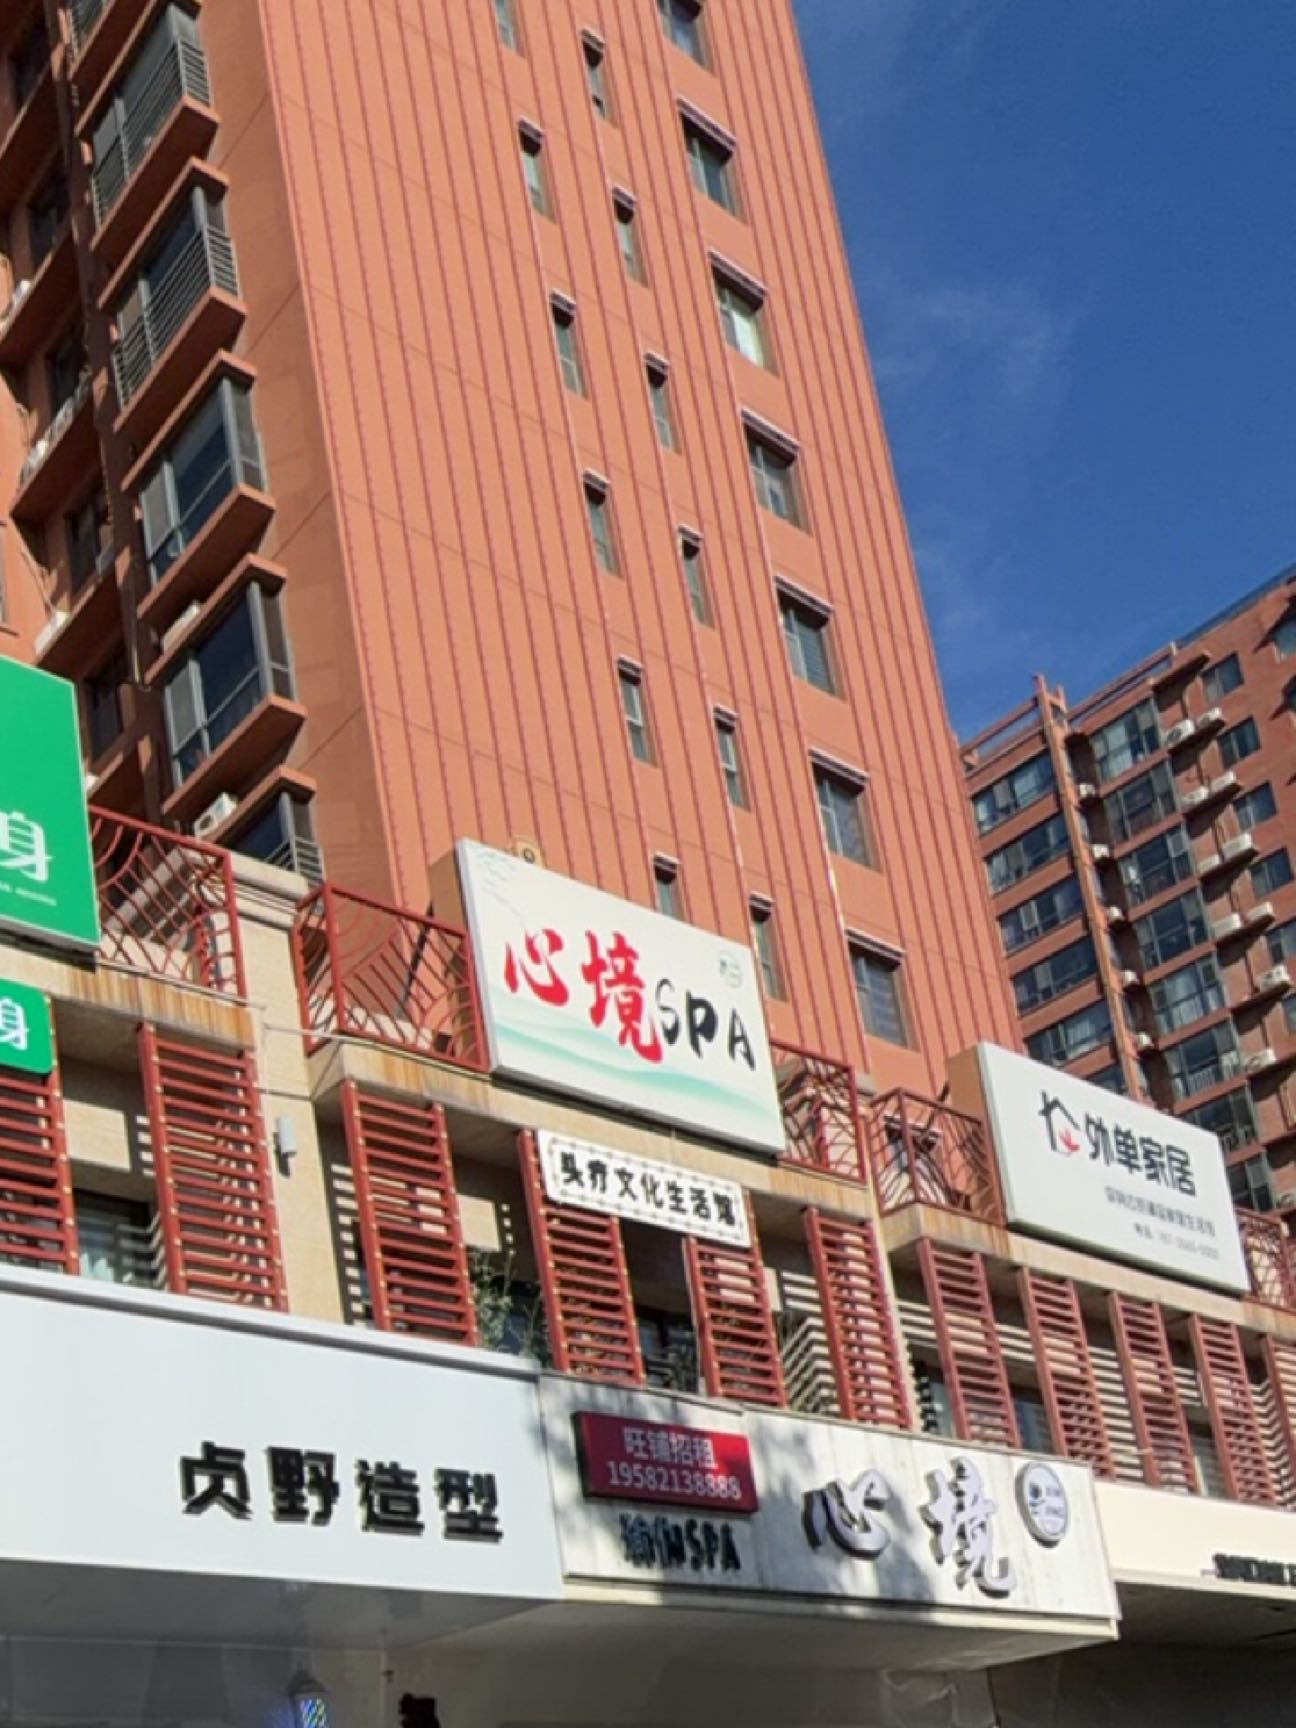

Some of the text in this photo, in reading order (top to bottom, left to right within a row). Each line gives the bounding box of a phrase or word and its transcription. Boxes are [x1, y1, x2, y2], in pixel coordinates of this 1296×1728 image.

[560, 1151, 738, 1227] 头疗文化生活馆
[1084, 1111, 1196, 1196] 外单家居
[623, 1427, 718, 1469] 旺铺招租
[180, 1441, 504, 1543] 贞野造型
[804, 1456, 1017, 1598] 心境
